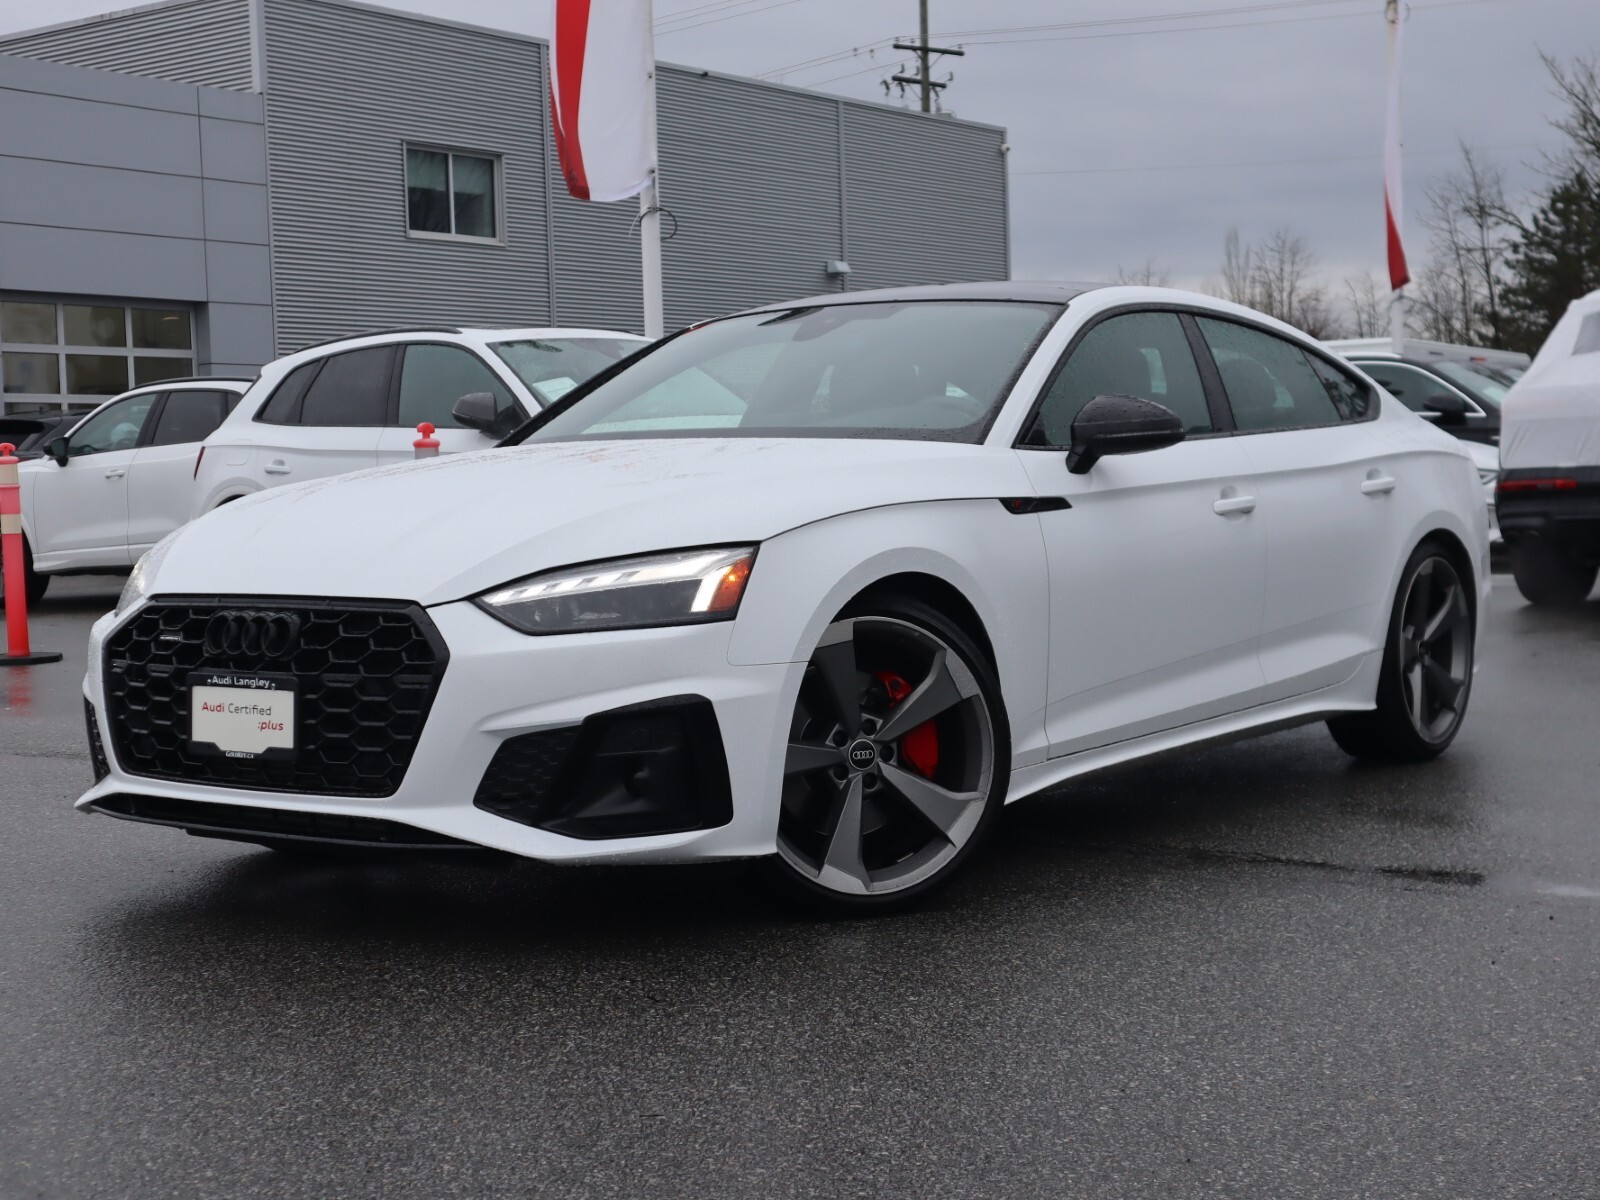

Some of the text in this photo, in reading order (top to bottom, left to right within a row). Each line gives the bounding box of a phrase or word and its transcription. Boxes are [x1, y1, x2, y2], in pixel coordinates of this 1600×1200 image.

[212, 676, 270, 688] Audi Langley
[202, 702, 271, 716] Audi Certified
